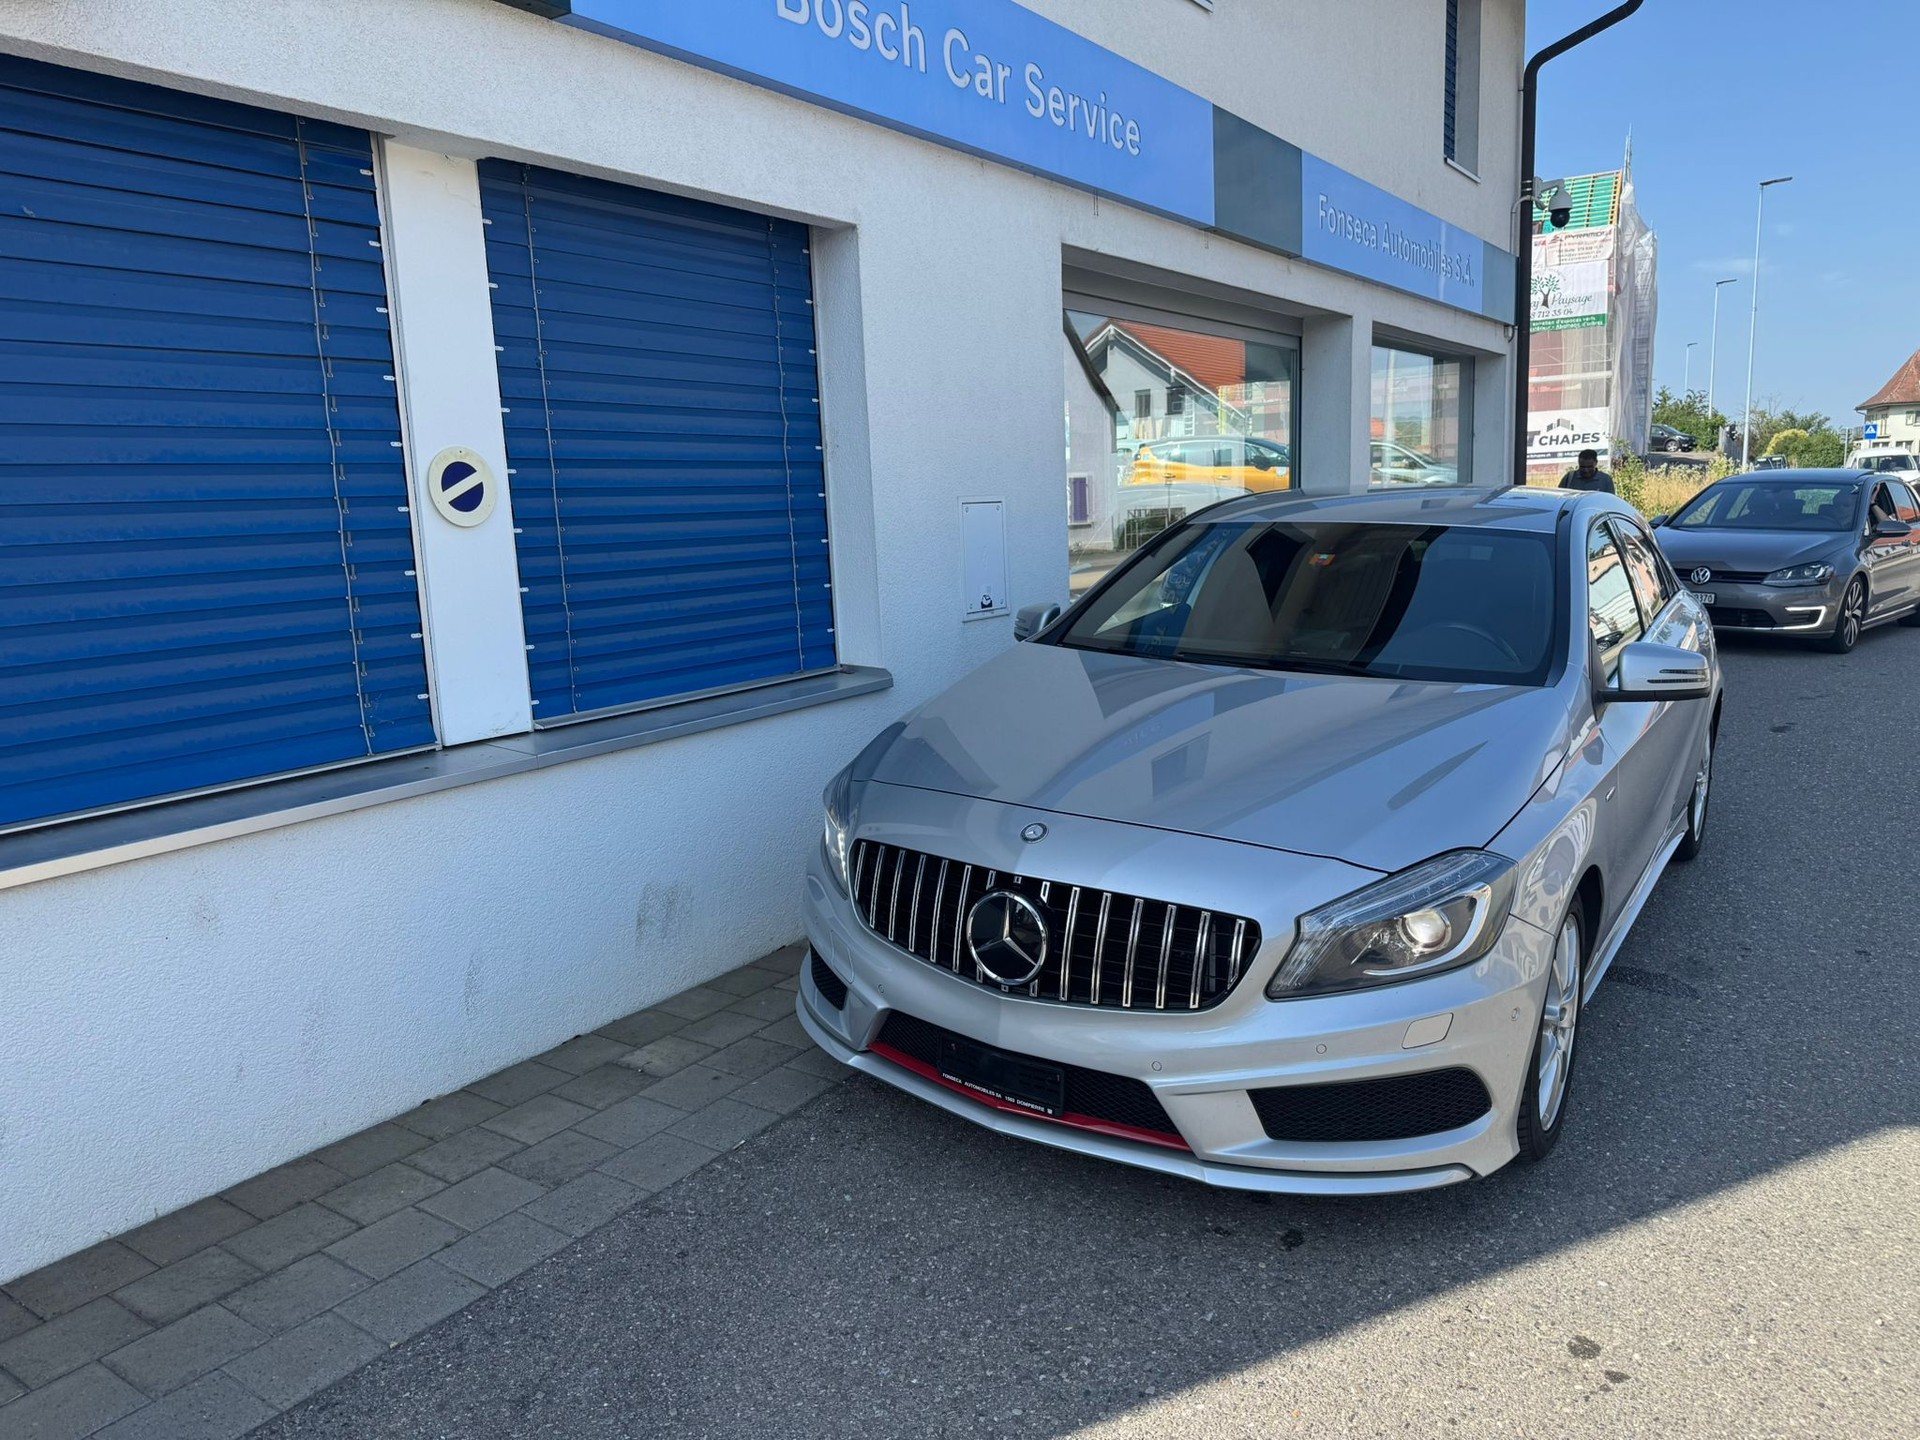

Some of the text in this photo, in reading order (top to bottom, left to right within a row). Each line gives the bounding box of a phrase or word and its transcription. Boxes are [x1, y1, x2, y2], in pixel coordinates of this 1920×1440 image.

[943, 28, 1011, 104] Car
[1025, 62, 1142, 155] Service
[1319, 193, 1475, 287] Fonseca Automobiles S.A.
[1551, 292, 1592, 305] Paysage
[1538, 310, 1550, 318] 712
[1552, 309, 1562, 317] 35
[1539, 432, 1600, 446] CHAPES
[943, 1073, 962, 1084] FONSECA
[964, 1081, 995, 1096] AUTOMOBILES
[1017, 1099, 1045, 1112] DOMPIERRE
